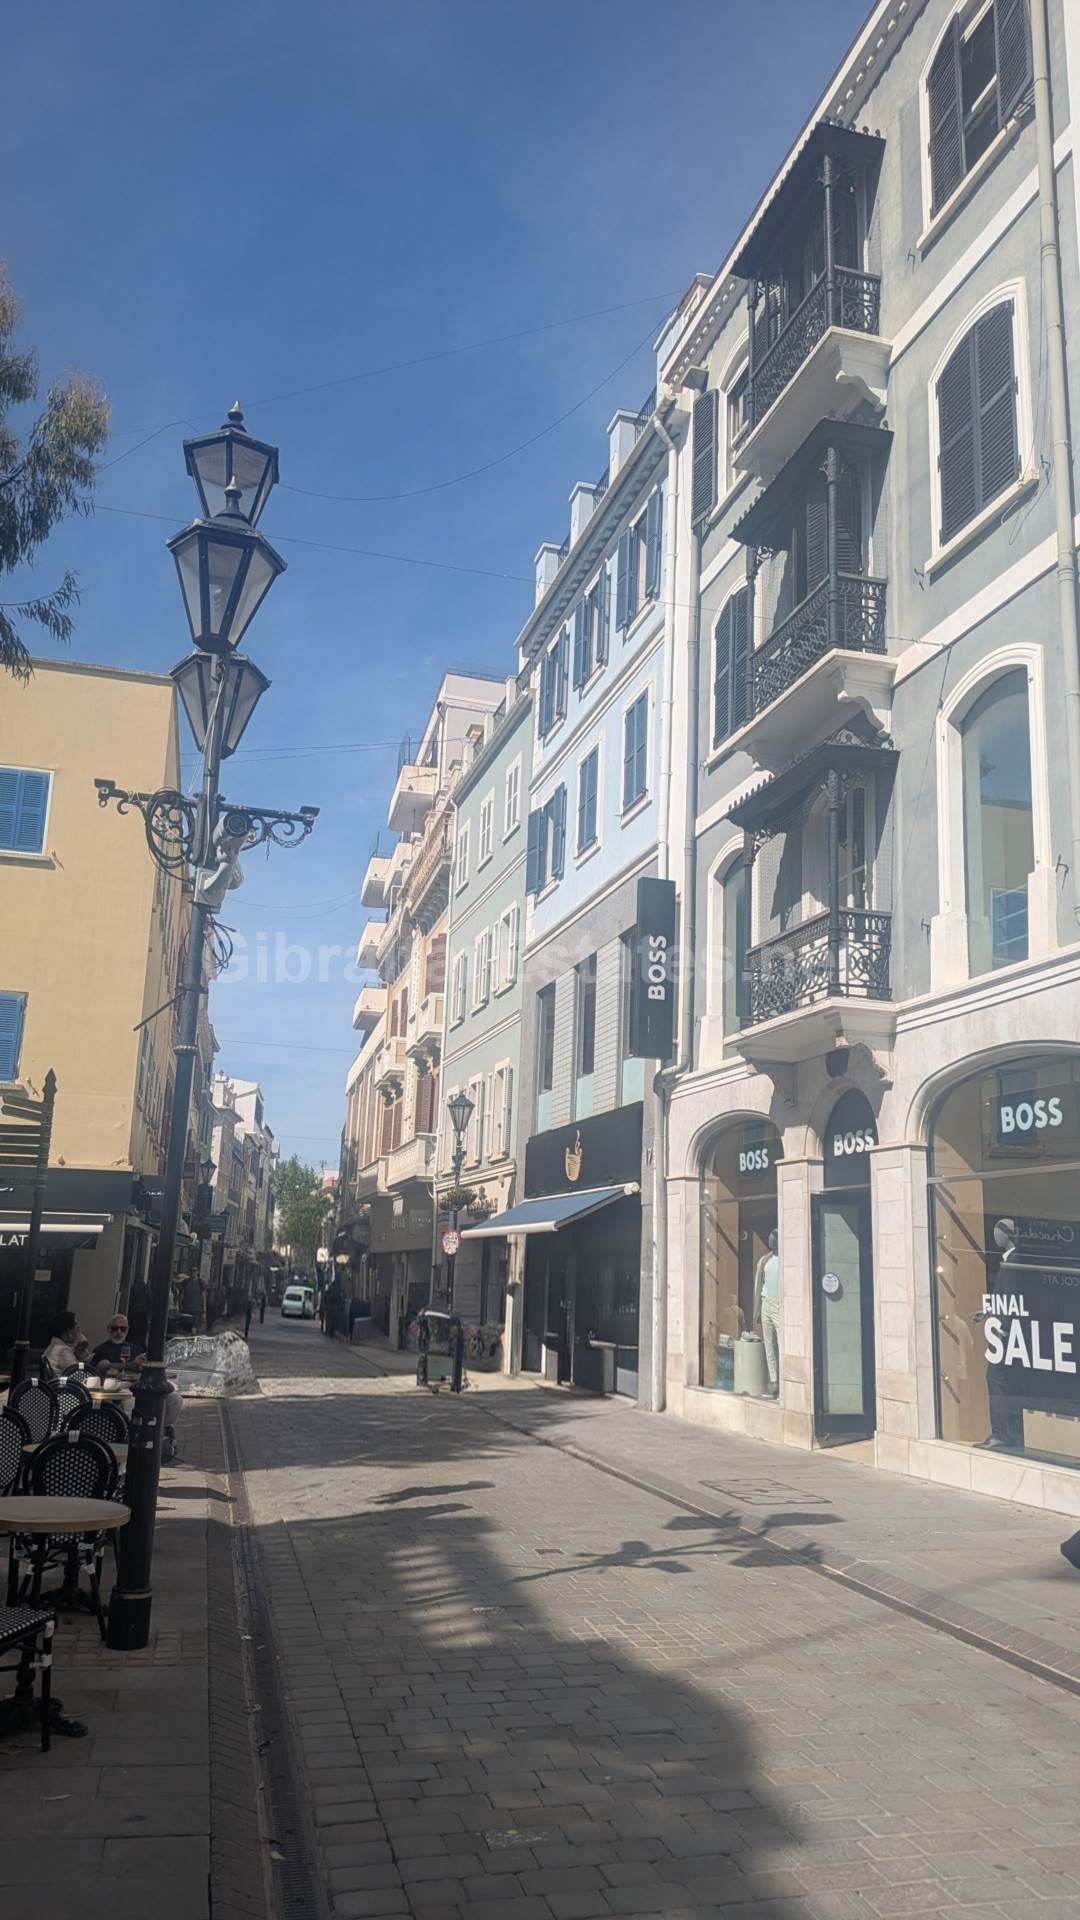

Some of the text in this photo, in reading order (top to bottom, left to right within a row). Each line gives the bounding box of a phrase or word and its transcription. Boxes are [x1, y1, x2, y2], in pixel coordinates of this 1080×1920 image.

[647, 934, 668, 1001] BOSS
[1000, 1097, 1063, 1133] BOSS
[833, 1128, 875, 1157] BOSS
[739, 1148, 769, 1172] BOSS
[982, 1294, 1029, 1316] FINAL
[984, 1317, 1077, 1373] SALE
